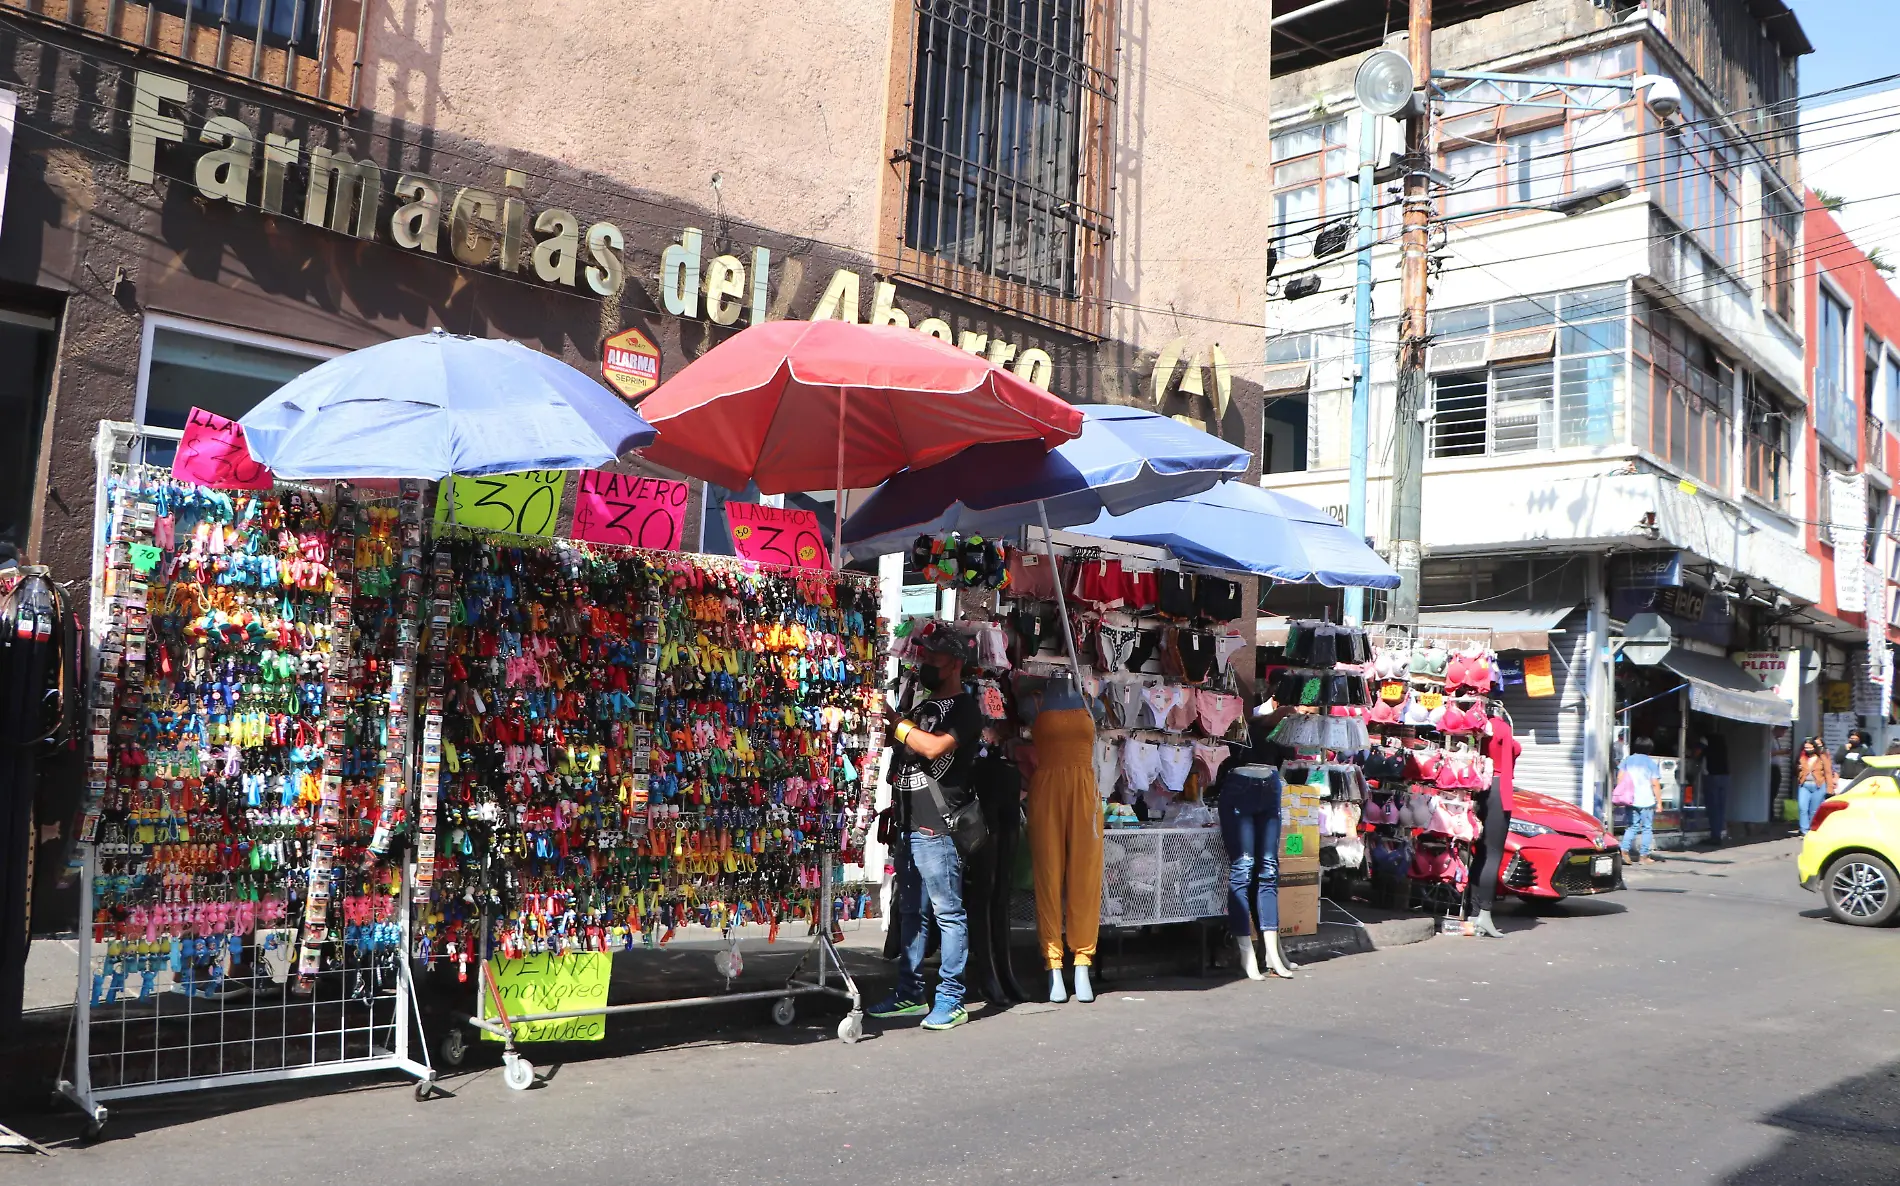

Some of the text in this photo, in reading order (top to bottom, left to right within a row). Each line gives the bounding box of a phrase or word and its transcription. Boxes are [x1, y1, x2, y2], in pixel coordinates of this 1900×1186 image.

[128, 70, 625, 296] Farmacias
[659, 227, 770, 326] del
[607, 348, 656, 374] ALARMA
[615, 373, 647, 387] SEPRIMI
[580, 468, 688, 507] LLAVERO
[140, 549, 155, 560] 70
[1742, 660, 1786, 670] PLATA
[1759, 673, 1768, 683] Y
[494, 951, 600, 981] VENTA
